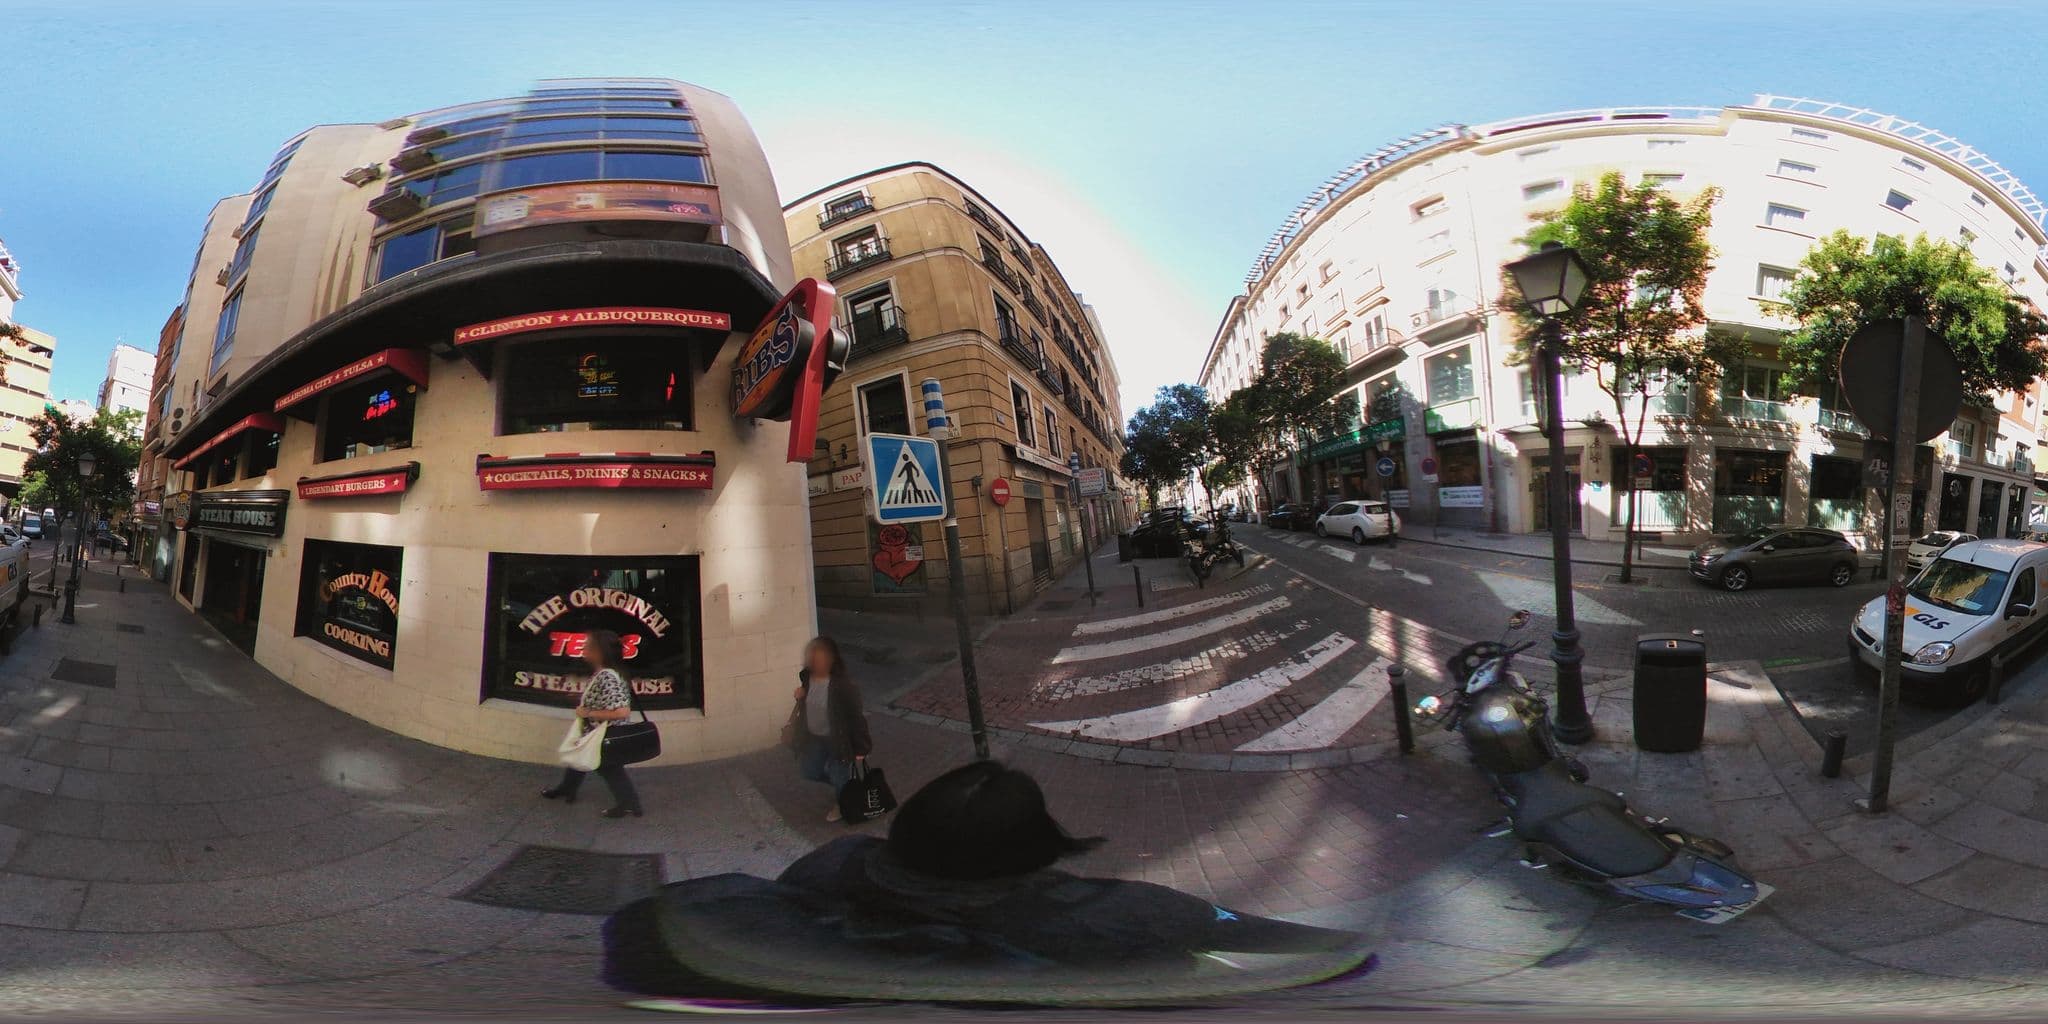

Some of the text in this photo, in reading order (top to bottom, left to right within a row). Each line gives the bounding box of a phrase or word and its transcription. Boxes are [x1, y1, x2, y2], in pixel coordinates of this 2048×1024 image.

[469, 311, 713, 337] CLINTON ALBUQUERQUE
[733, 300, 798, 417] RIBS
[279, 360, 374, 407] OKLAHOMA CITY TULSA
[306, 479, 386, 495] LEGENDARY BURGERS
[576, 467, 629, 479] DRINKS
[632, 469, 640, 479] &
[643, 468, 697, 481] SNACKS
[200, 508, 232, 522] STEAK
[233, 510, 276, 526] HOUSE
[518, 587, 670, 638] THE ORIGINAL
[1912, 613, 1950, 630] GLS
[324, 622, 389, 656] COOKING
[550, 632, 642, 659] TES
